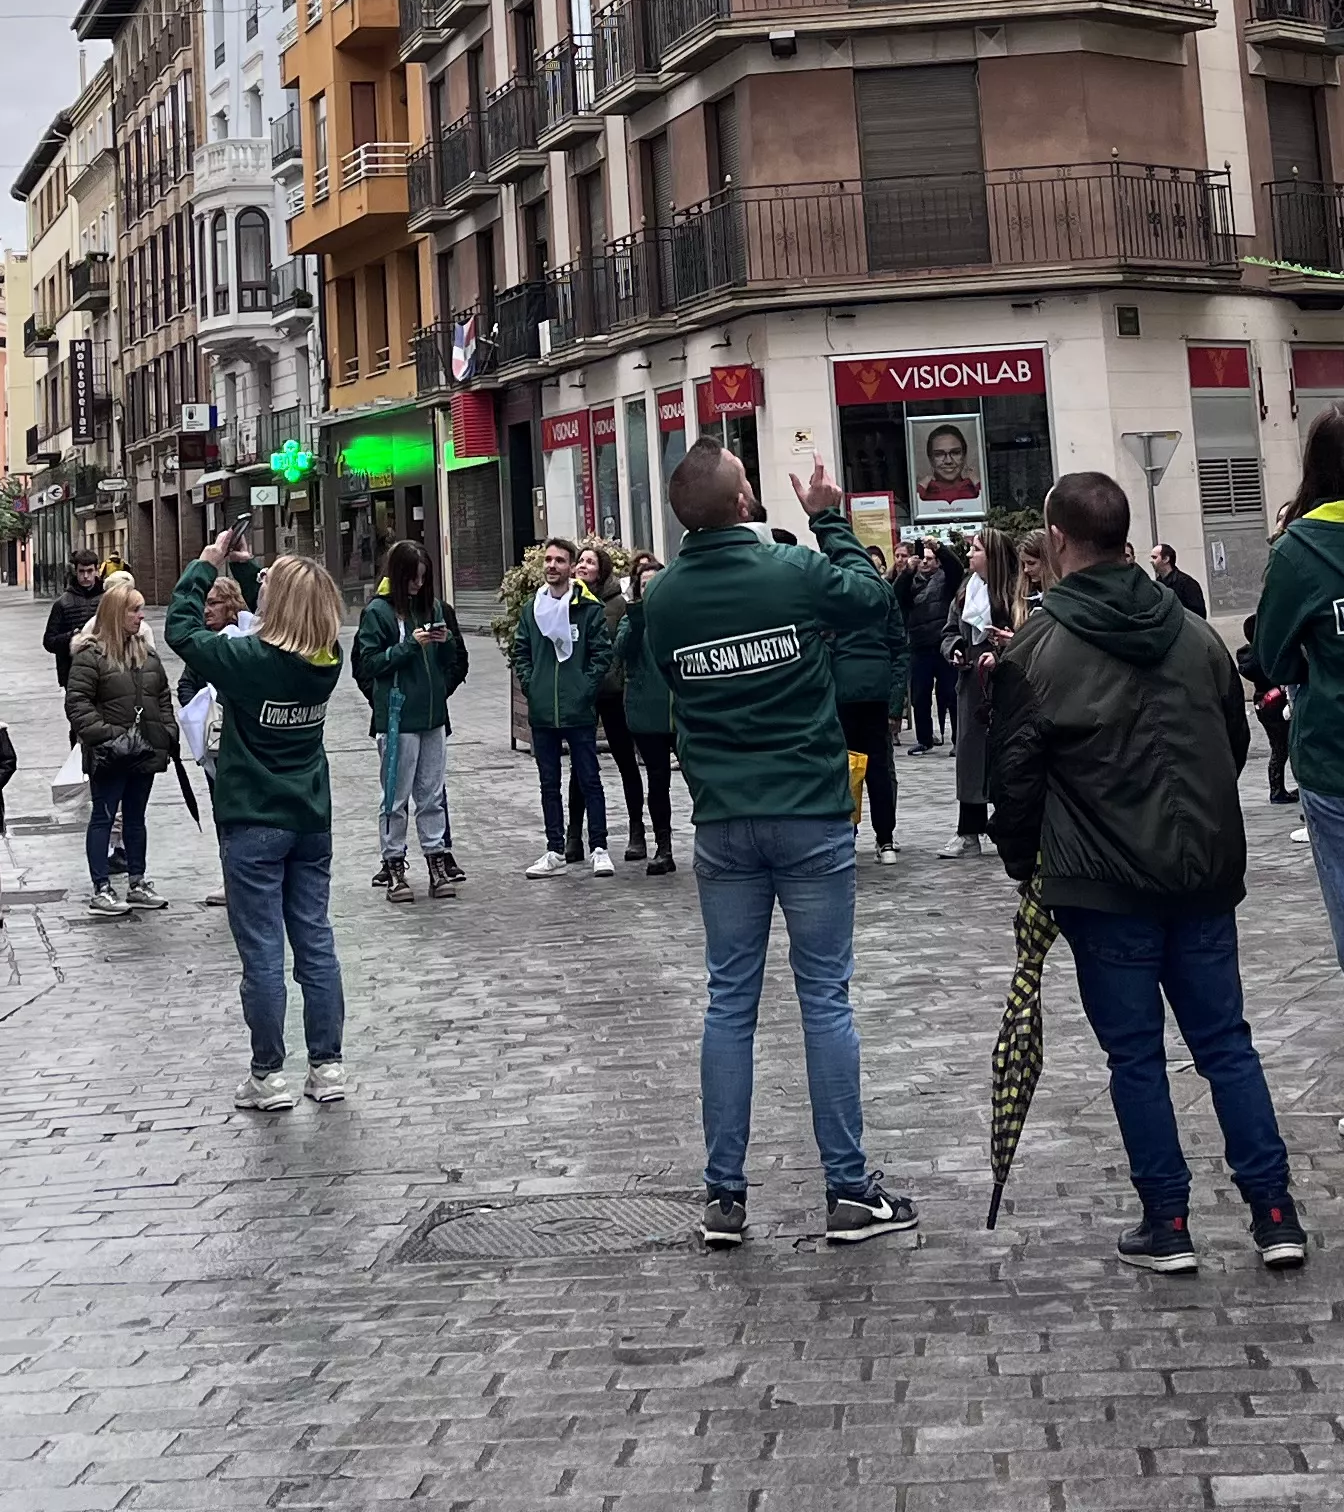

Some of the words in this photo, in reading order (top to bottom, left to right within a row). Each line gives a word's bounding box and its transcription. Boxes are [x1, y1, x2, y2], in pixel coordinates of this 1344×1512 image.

[74, 341, 87, 435] Montovelaz
[889, 360, 1032, 390] VISIONLAB
[714, 401, 754, 411] VISIONLAB
[551, 419, 579, 442] VISIONLAB
[709, 644, 740, 672] SAN
[739, 633, 796, 666] MARTIN
[266, 706, 290, 725] VIVA
[288, 707, 309, 724] SAN
